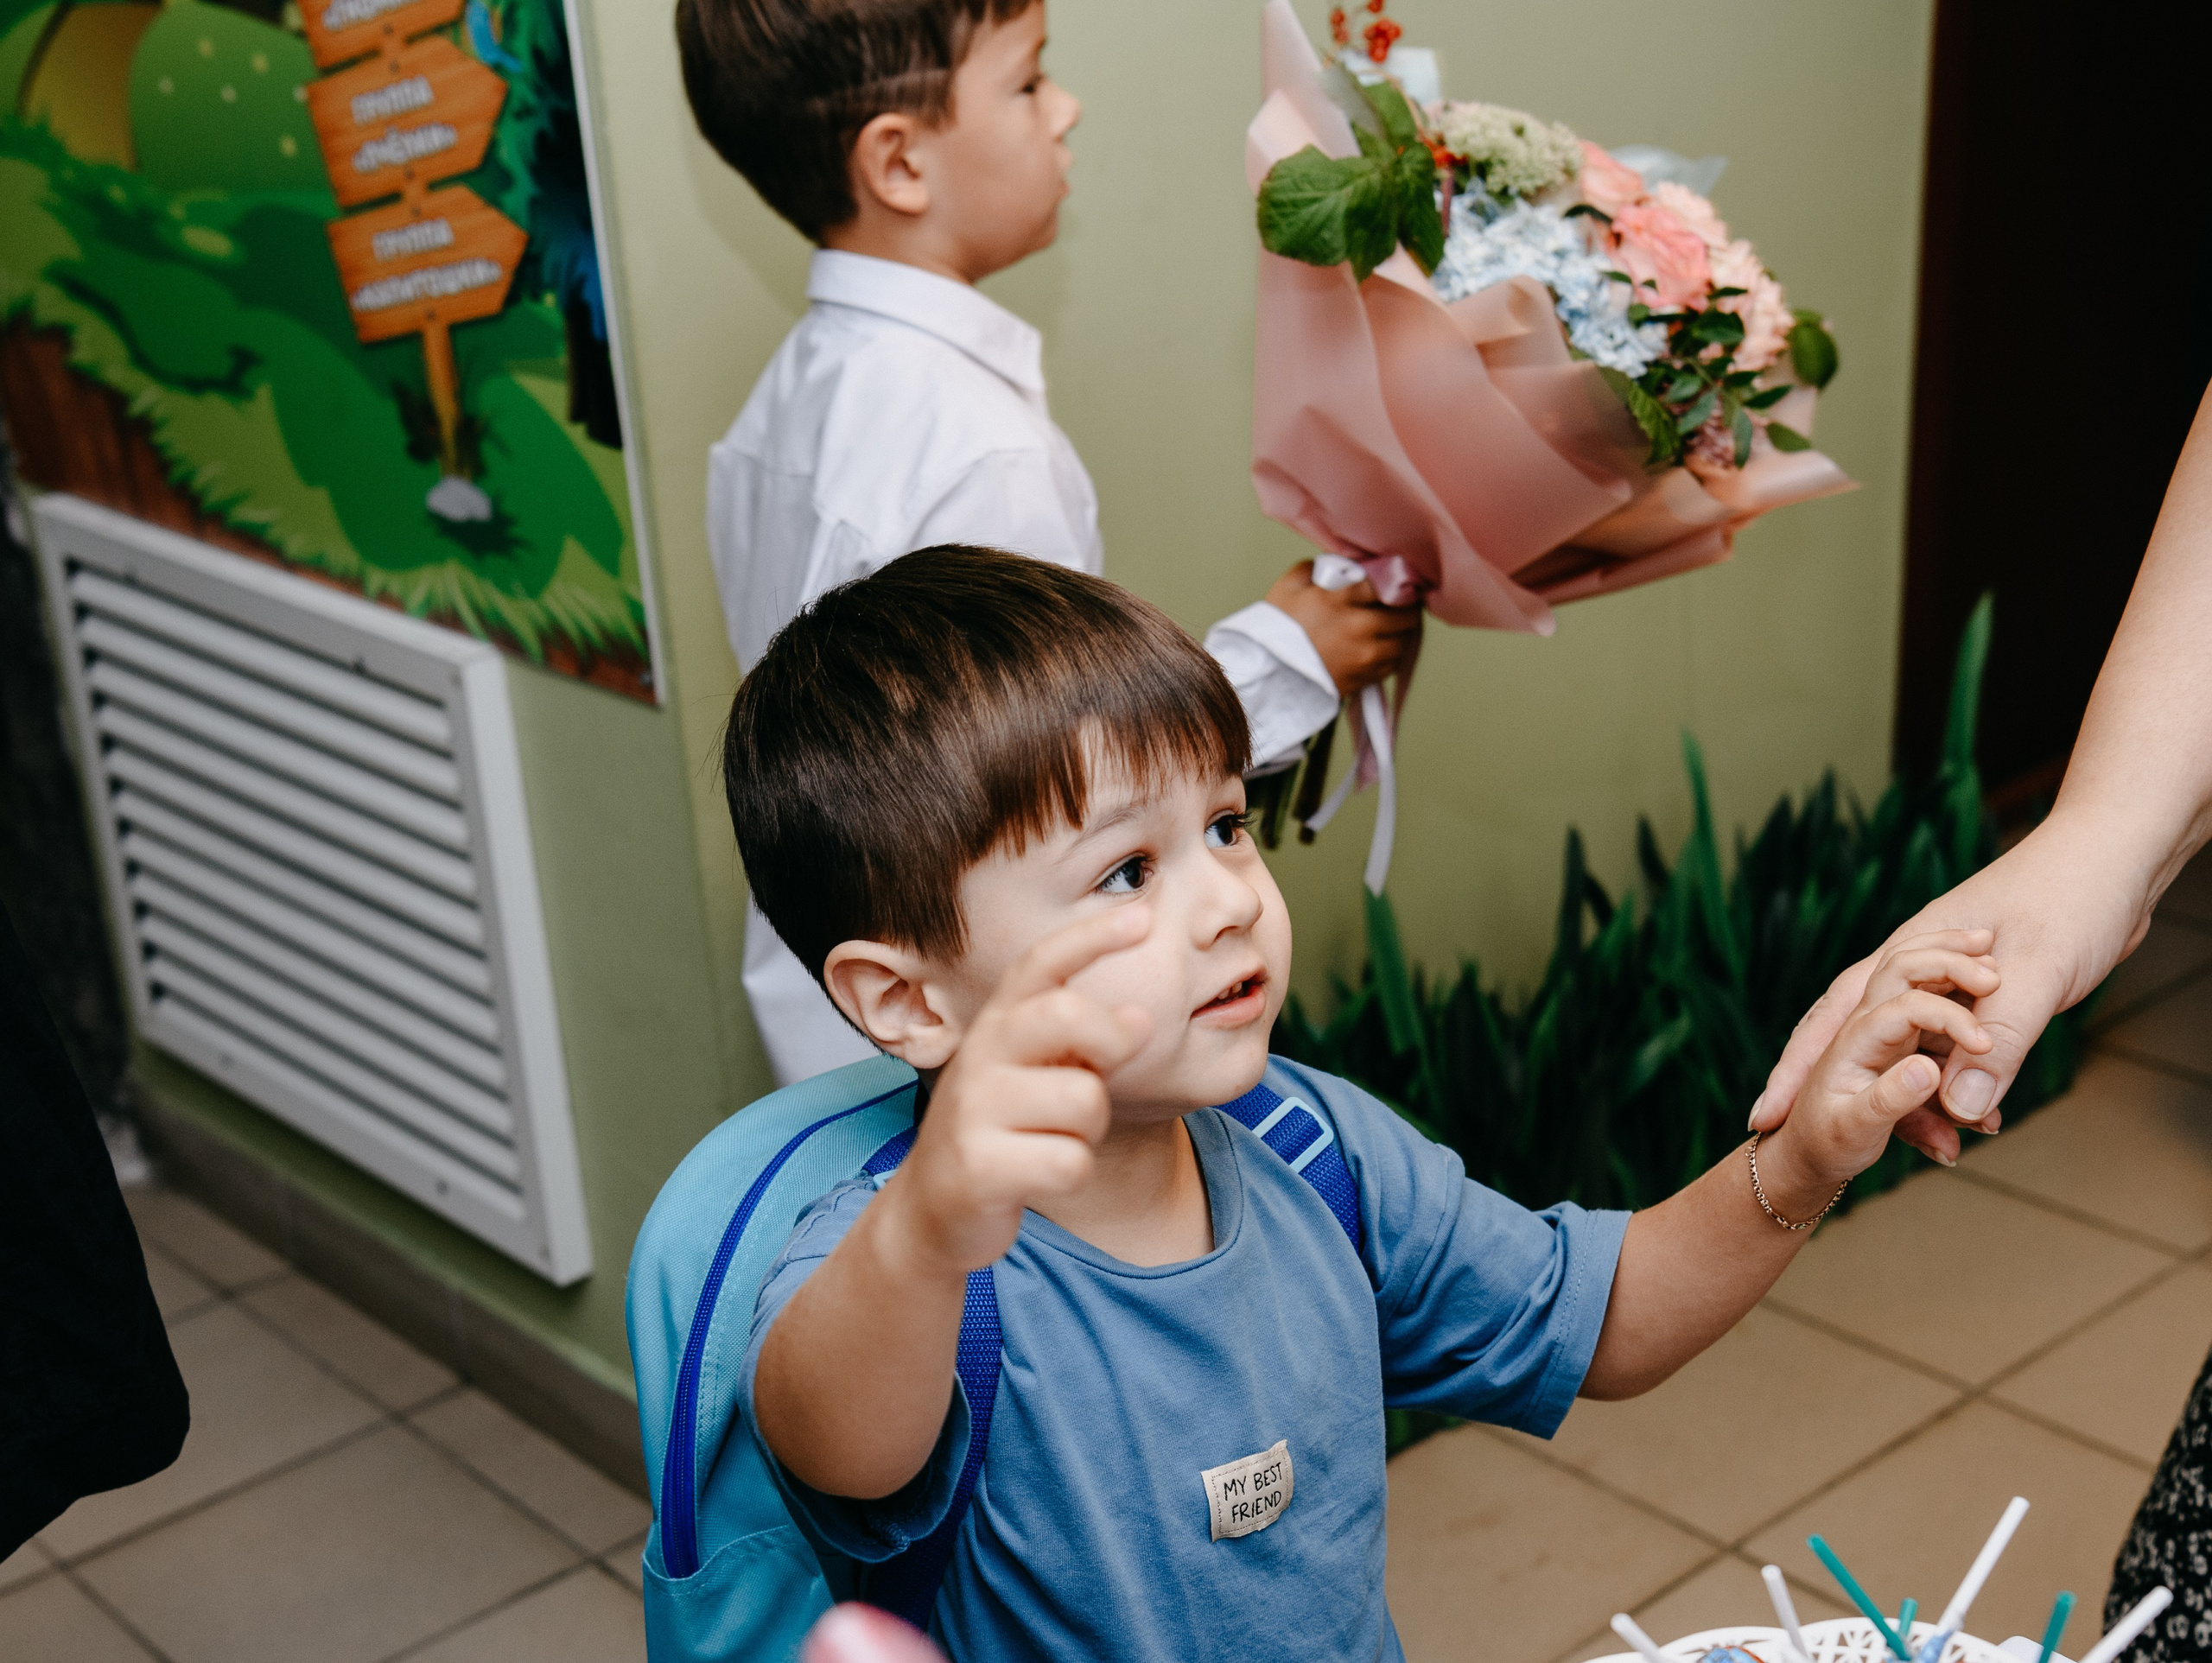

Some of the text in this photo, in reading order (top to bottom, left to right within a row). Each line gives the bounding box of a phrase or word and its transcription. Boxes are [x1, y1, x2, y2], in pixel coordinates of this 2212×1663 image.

[1224, 1462, 1282, 1501] MY BEST
[1232, 1490, 1282, 1524] FRIEND
